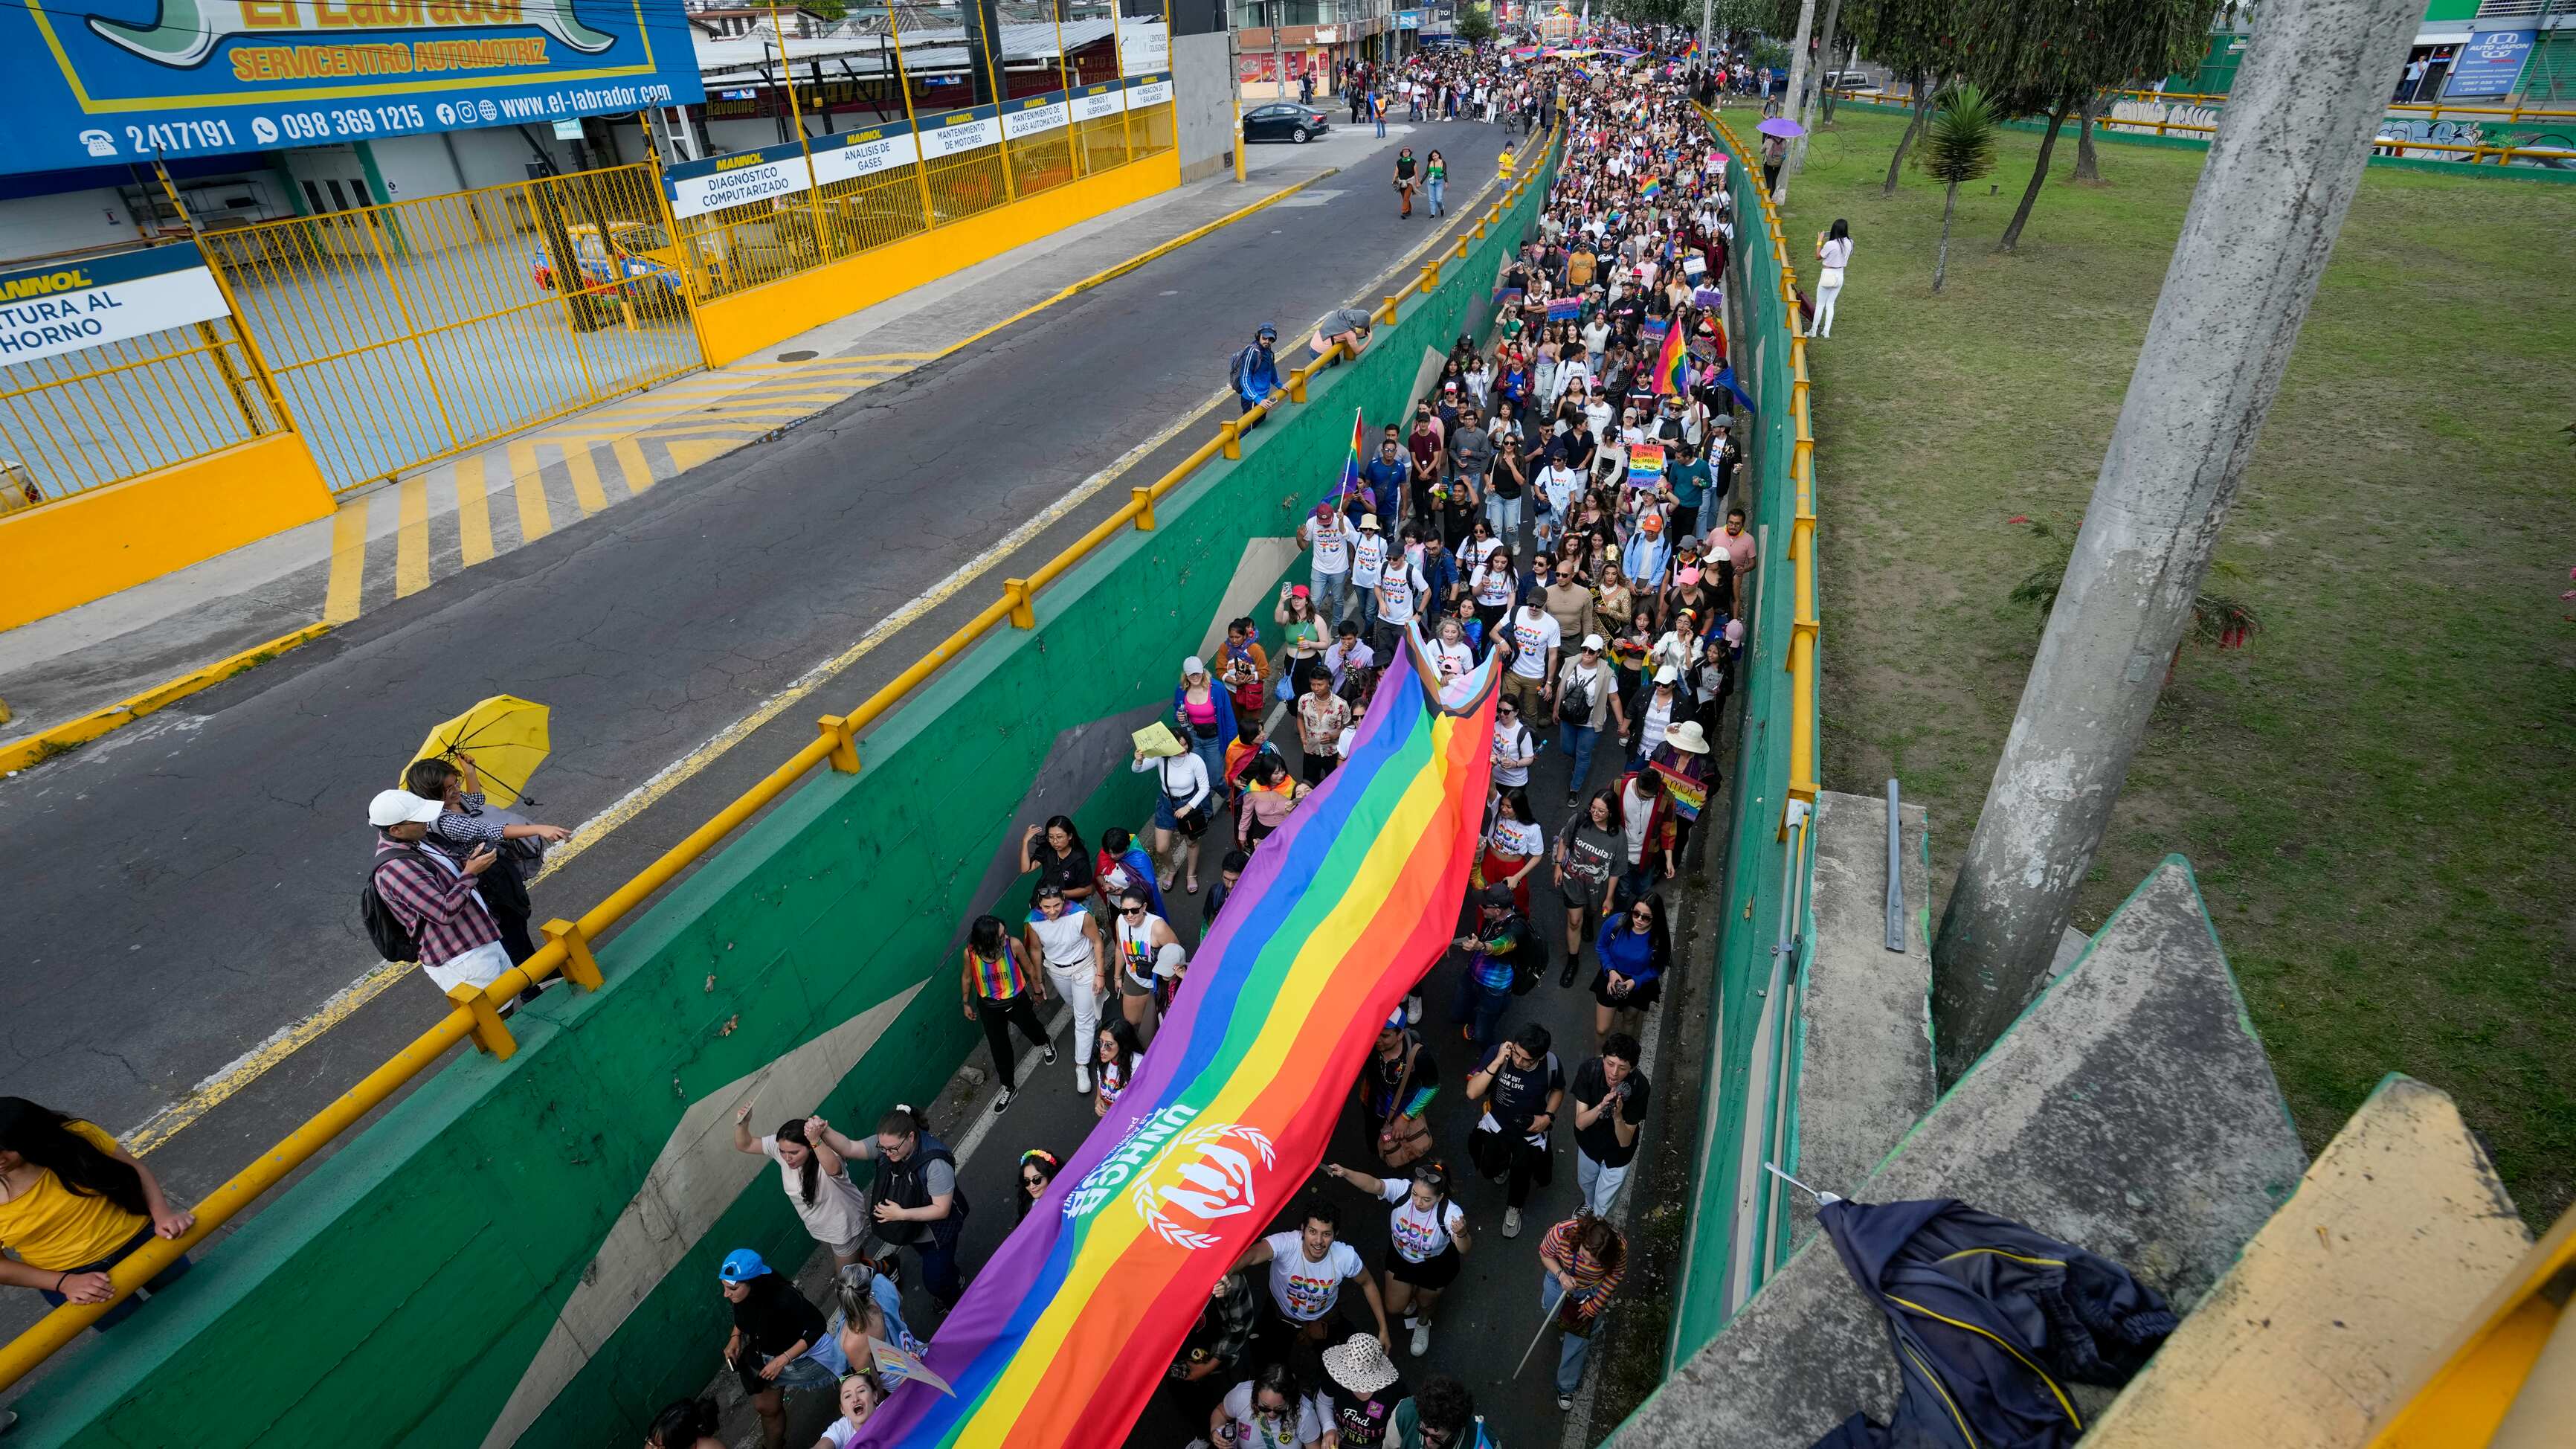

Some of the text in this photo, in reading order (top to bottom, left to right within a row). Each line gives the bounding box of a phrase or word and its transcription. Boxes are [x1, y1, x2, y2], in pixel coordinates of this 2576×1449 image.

[229, 37, 550, 82] SERVICENTRO AUTOMOTRIZ
[499, 83, 672, 118] www.el-labrador.com
[1089, 97, 1105, 106] FRENOS
[946, 112, 974, 126] MANNOL
[1012, 105, 1060, 123] MANTENIMIENTO DE
[126, 104, 424, 153] 2417191 098 369 1215
[847, 129, 883, 145] MANNOL
[937, 123, 985, 140] MANTENIMIENTO
[1011, 124, 1029, 134] CAJAS
[880, 142, 891, 153] DE
[944, 134, 982, 150] DE MOTORES
[716, 152, 764, 172] MANNOL
[857, 156, 883, 171] GASES
[708, 167, 777, 191] DIAGNÓSTICO
[702, 178, 789, 207] COMPUTARIZADO
[0, 291, 123, 330] TURA AL
[0, 318, 103, 353] HORNO
[1317, 529, 1338, 537] SOY
[1358, 546, 1377, 556] SOY
[1384, 577, 1405, 587] SOY
[1516, 626, 1542, 640] SOY
[1496, 823, 1523, 844] SOY
[1511, 1082, 1524, 1090] LOVE
[1078, 1104, 1200, 1217] UNHCR
[1395, 1216, 1434, 1242] SOY
[1288, 1274, 1334, 1295] SOY
[1343, 1408, 1370, 1427] Find
[1344, 1428, 1369, 1445] THAT
